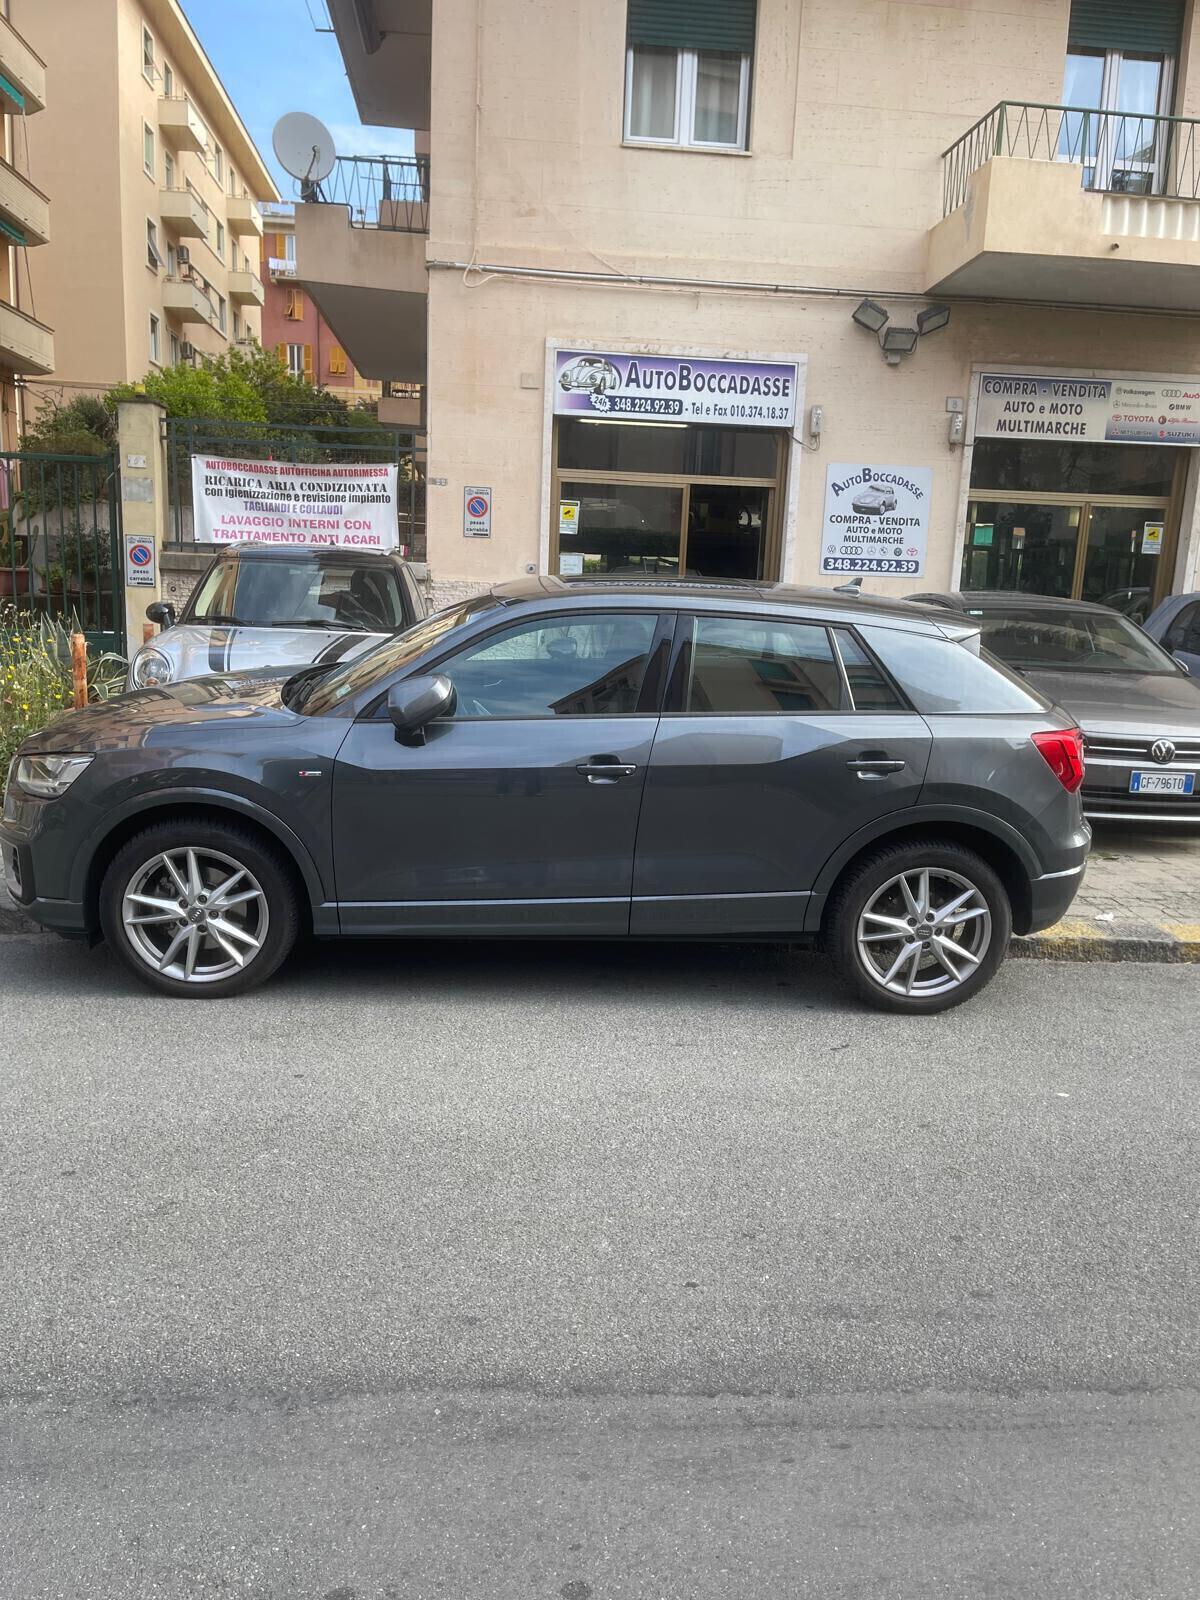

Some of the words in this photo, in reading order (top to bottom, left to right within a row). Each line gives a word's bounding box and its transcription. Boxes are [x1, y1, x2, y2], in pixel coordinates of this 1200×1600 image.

[984, 380, 1037, 395] COMPRA
[1052, 383, 1107, 398] VENDITA
[614, 397, 680, 414] 348.224.92.39
[691, 402, 703, 415] Tel
[705, 406, 711, 416] e
[713, 403, 728, 417] Fax
[730, 404, 789, 420] 010.374.18.37
[1003, 400, 1035, 414] AUTO
[1038, 405, 1045, 414] e
[1049, 402, 1083, 416] MOTO
[1123, 414, 1154, 423] TOYOTA
[996, 419, 1087, 435] MULTIMARCHE
[205, 460, 278, 475] AUTOBOCCADASSE
[279, 466, 331, 477] AUTOFFICINA
[332, 468, 389, 477] AUTORIMESSA
[205, 475, 263, 489] RICARICA
[267, 480, 296, 491] ARIA
[299, 481, 387, 493] CONDIZIONATA
[204, 487, 223, 497] con
[225, 486, 292, 502] igienizzazione
[293, 493, 300, 502] e
[301, 492, 347, 503] revisione
[348, 493, 391, 504] impianto
[243, 500, 290, 513] TAGLIANDI
[292, 504, 297, 513] E
[299, 504, 343, 515] COLLAUDI
[221, 514, 284, 528] LAVAGGIO
[288, 518, 339, 529] INTERNI
[343, 520, 371, 530] CON
[829, 515, 871, 524] COMPRA
[879, 516, 921, 527] VENDITA
[213, 528, 306, 543] TRATTAMENTO
[310, 533, 339, 544] ANTI
[343, 534, 380, 545] ACARI
[846, 525, 870, 534] AUTO
[877, 527, 903, 536] MOTO
[843, 535, 905, 545] MULTIMARCHE
[826, 559, 916, 572] 348.224.92.39
